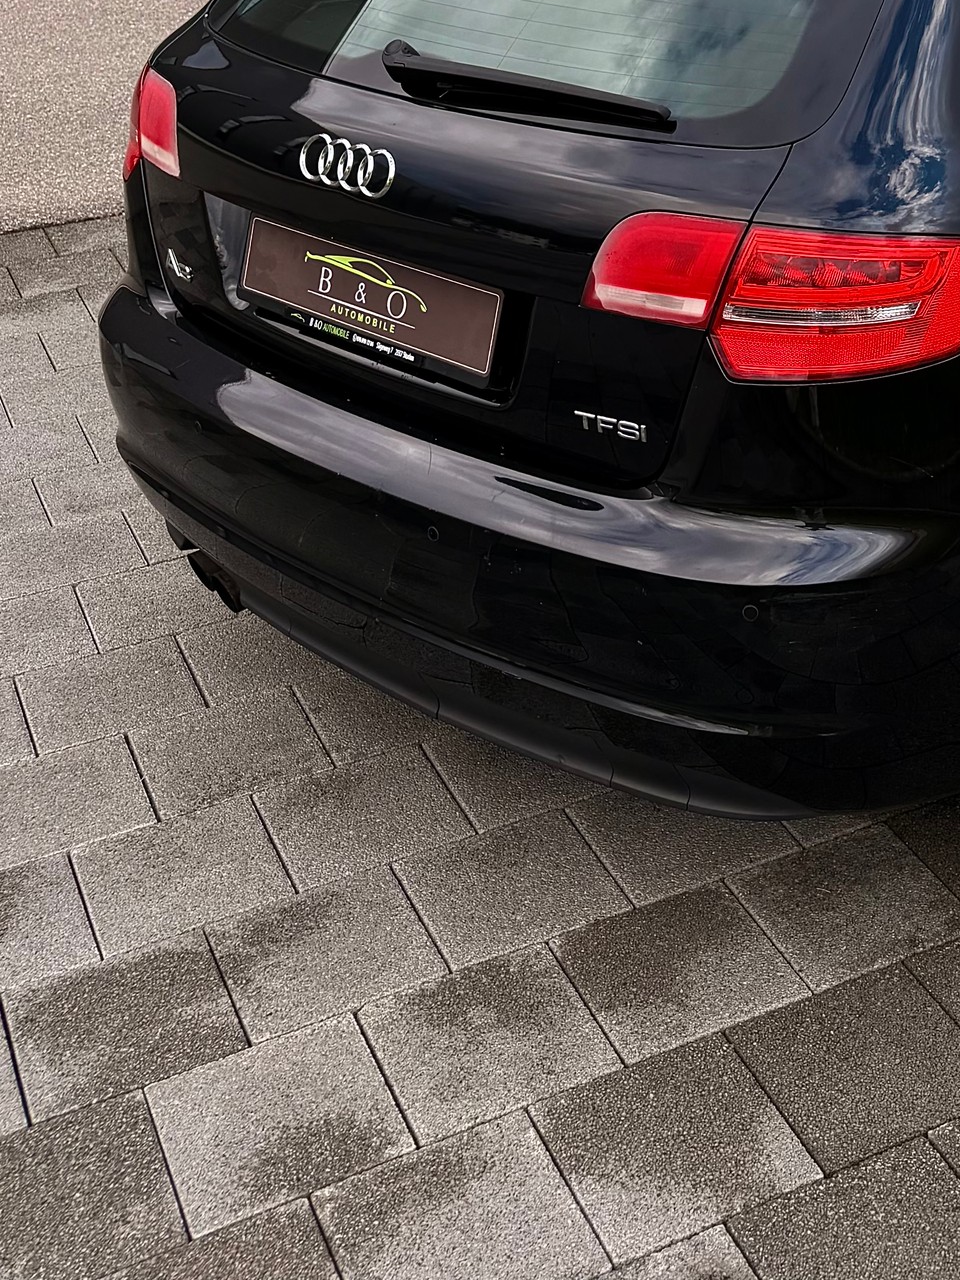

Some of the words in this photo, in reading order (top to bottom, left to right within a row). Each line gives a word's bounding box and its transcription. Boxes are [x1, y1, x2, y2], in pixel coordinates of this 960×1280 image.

[319, 266, 333, 294] B
[355, 282, 367, 304] &
[387, 290, 407, 319] O
[322, 323, 350, 340] AUTOMOBILE
[330, 303, 396, 334] AUTOMOBILE
[574, 410, 647, 443] TFSI
